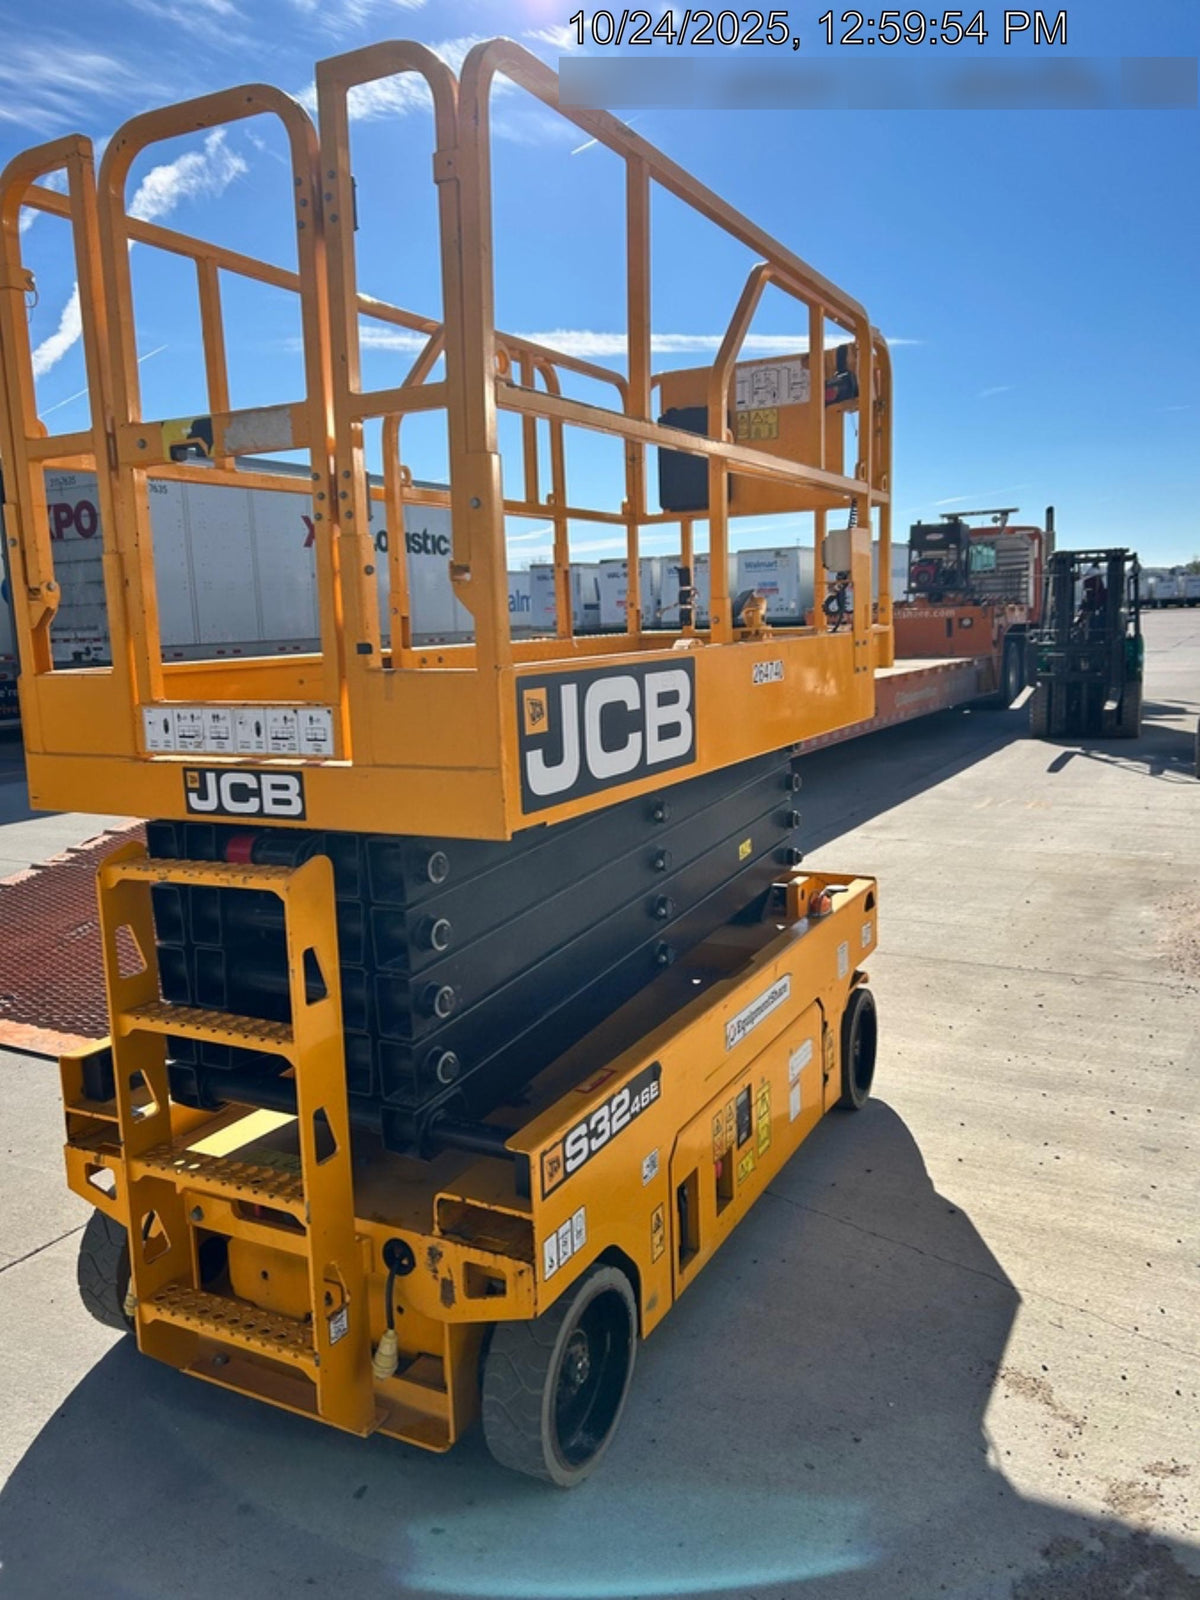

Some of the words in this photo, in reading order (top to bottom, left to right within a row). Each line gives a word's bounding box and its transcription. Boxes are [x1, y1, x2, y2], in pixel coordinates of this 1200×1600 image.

[753, 661, 784, 683] 264740
[525, 669, 693, 796] JCB
[188, 771, 302, 815] JCB
